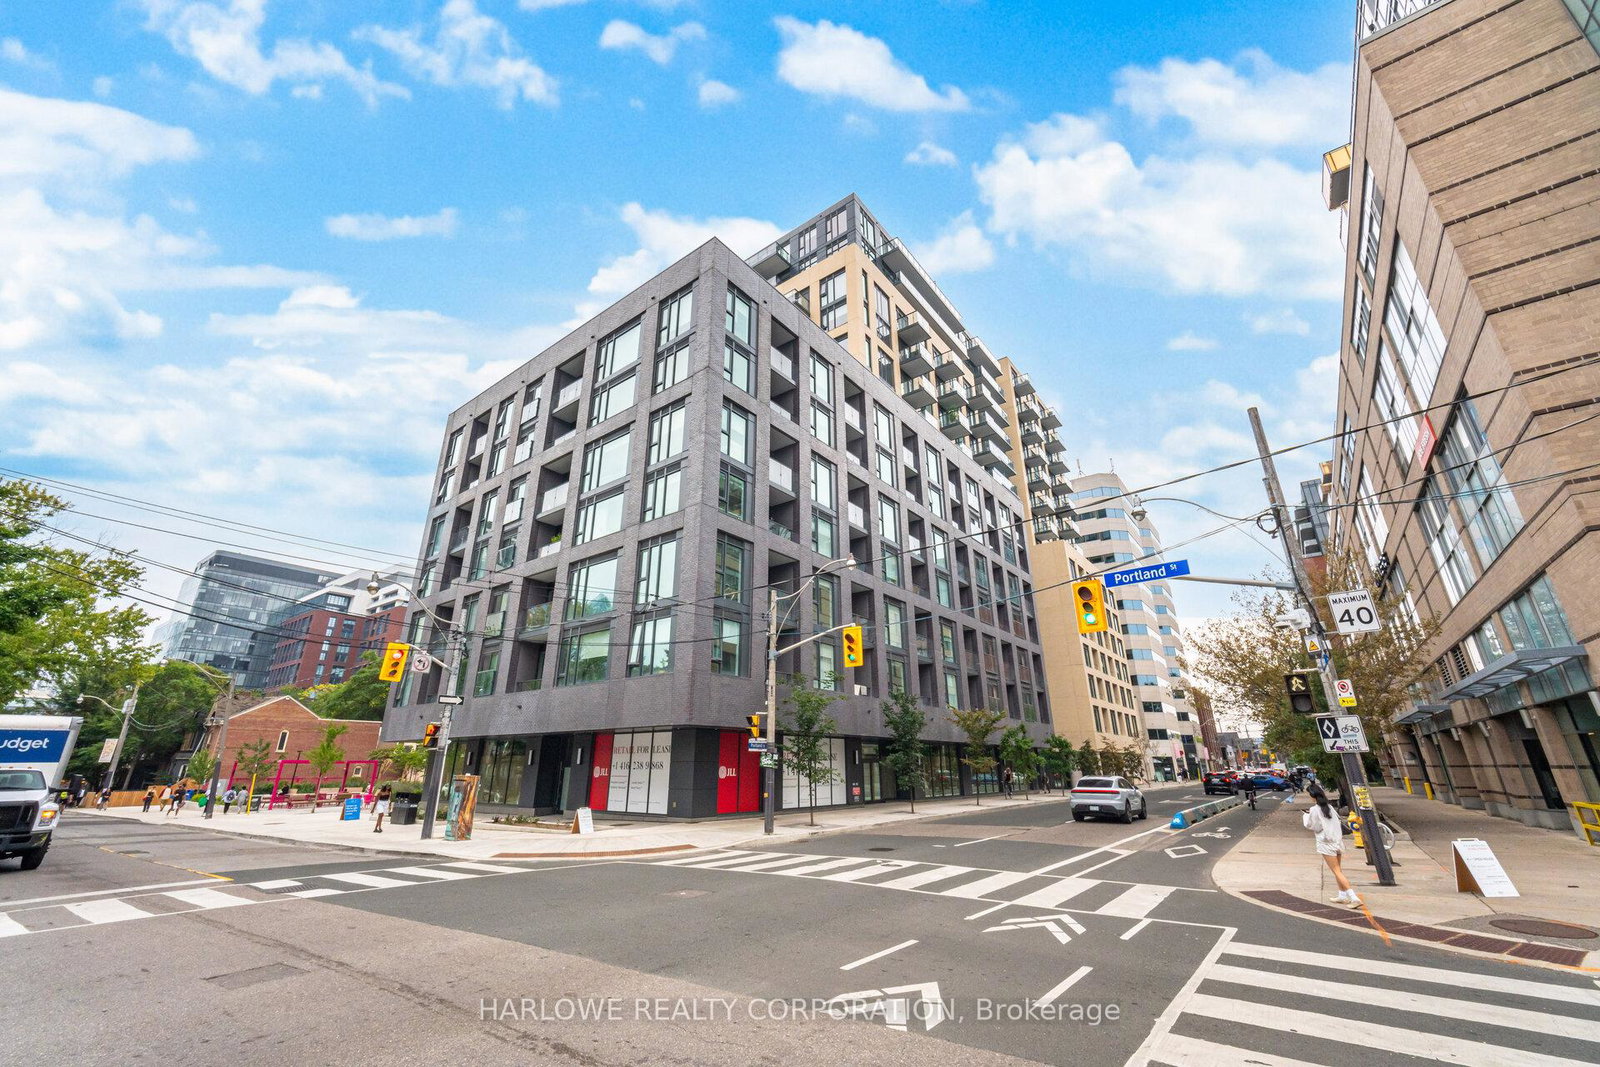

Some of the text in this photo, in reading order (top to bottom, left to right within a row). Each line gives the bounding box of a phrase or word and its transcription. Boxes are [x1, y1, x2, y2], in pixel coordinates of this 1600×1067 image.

[1114, 563, 1177, 584] Portland St
[1332, 594, 1367, 604] MAXIMUM
[1338, 607, 1373, 626] 40
[636, 745, 650, 754] FOR
[620, 761, 630, 770] 416
[632, 760, 644, 770] 238
[726, 767, 736, 776] JLL
